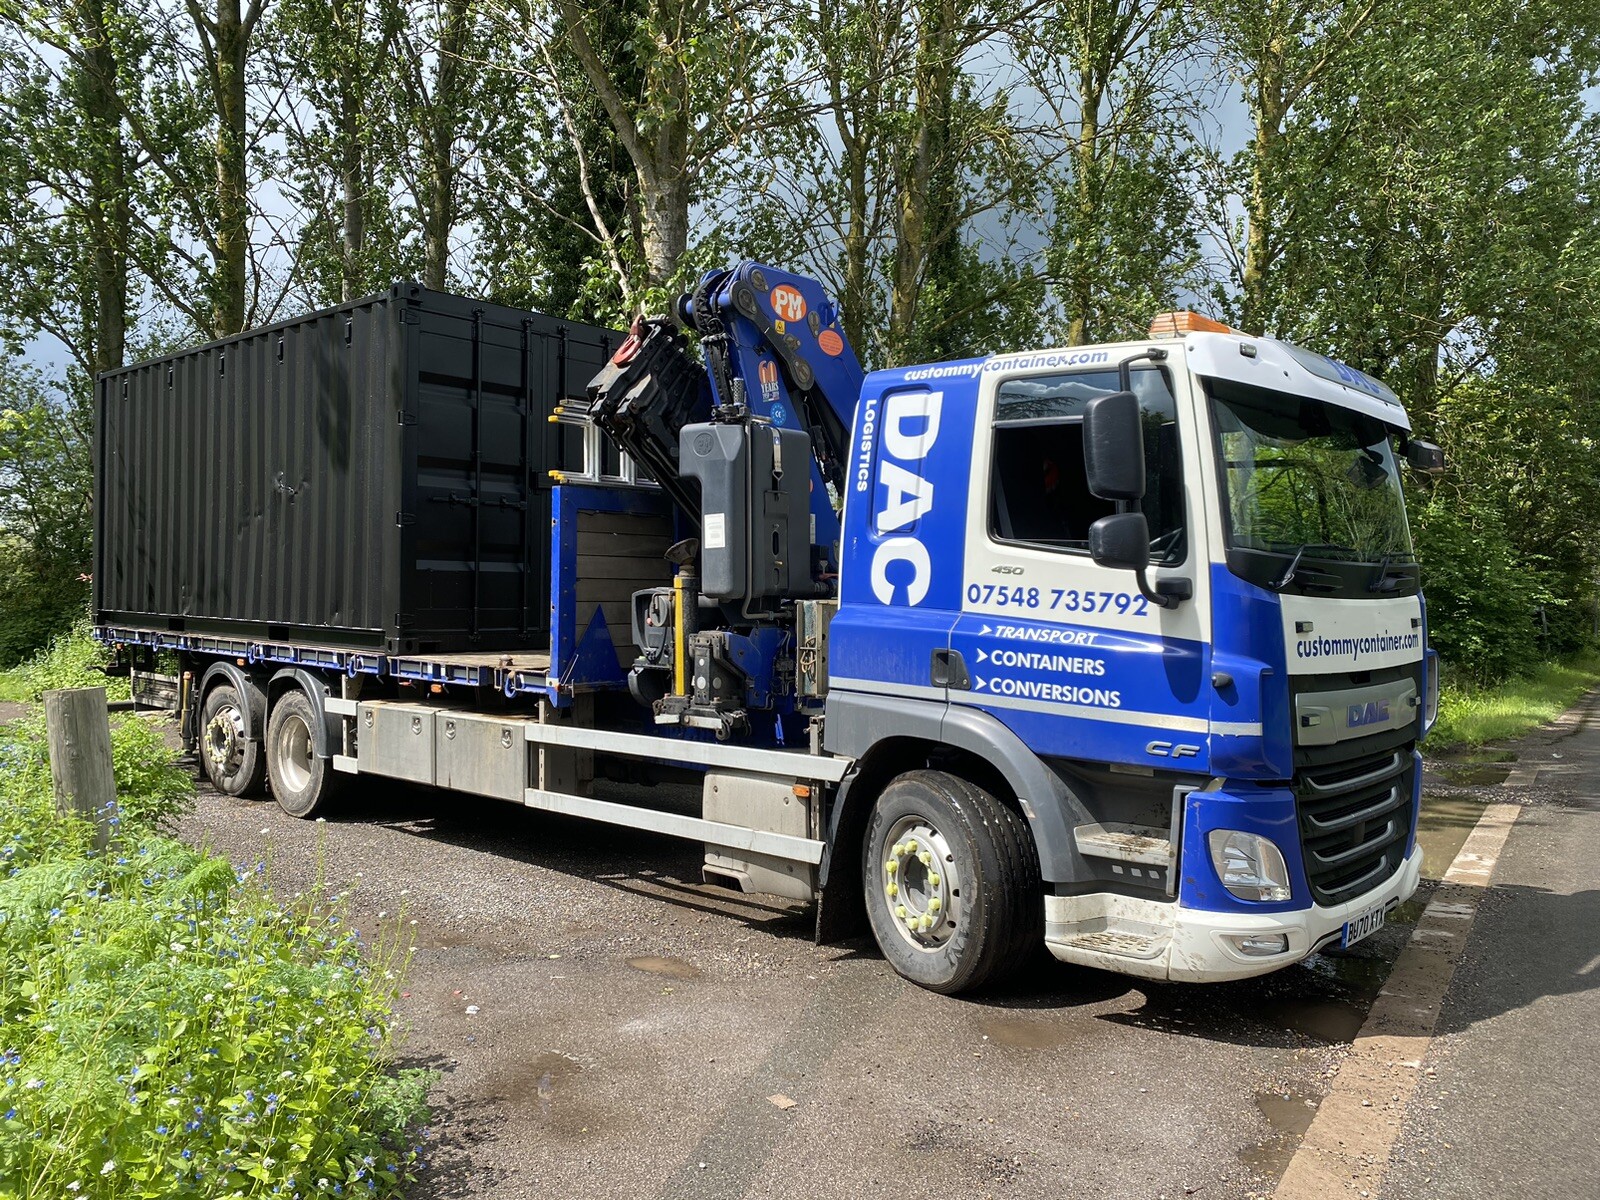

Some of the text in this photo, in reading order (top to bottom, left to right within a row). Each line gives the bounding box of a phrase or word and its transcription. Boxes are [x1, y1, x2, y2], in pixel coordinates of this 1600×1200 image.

[775, 288, 803, 320] PM
[904, 351, 1109, 381] custommycontainer.com
[761, 381, 779, 393] YEARS
[857, 399, 877, 493] LOGISTICS
[871, 391, 943, 607] DAC
[991, 565, 1024, 576] 450
[967, 584, 1149, 616] 07548 735792
[994, 626, 1098, 645] TRANSPORT
[1297, 630, 1419, 661] custommycontainer.com
[991, 650, 1105, 676] CONTAINERS
[990, 677, 1121, 707] CONVERSIONS
[1146, 741, 1200, 758] CF
[1348, 915, 1369, 943] BU70
